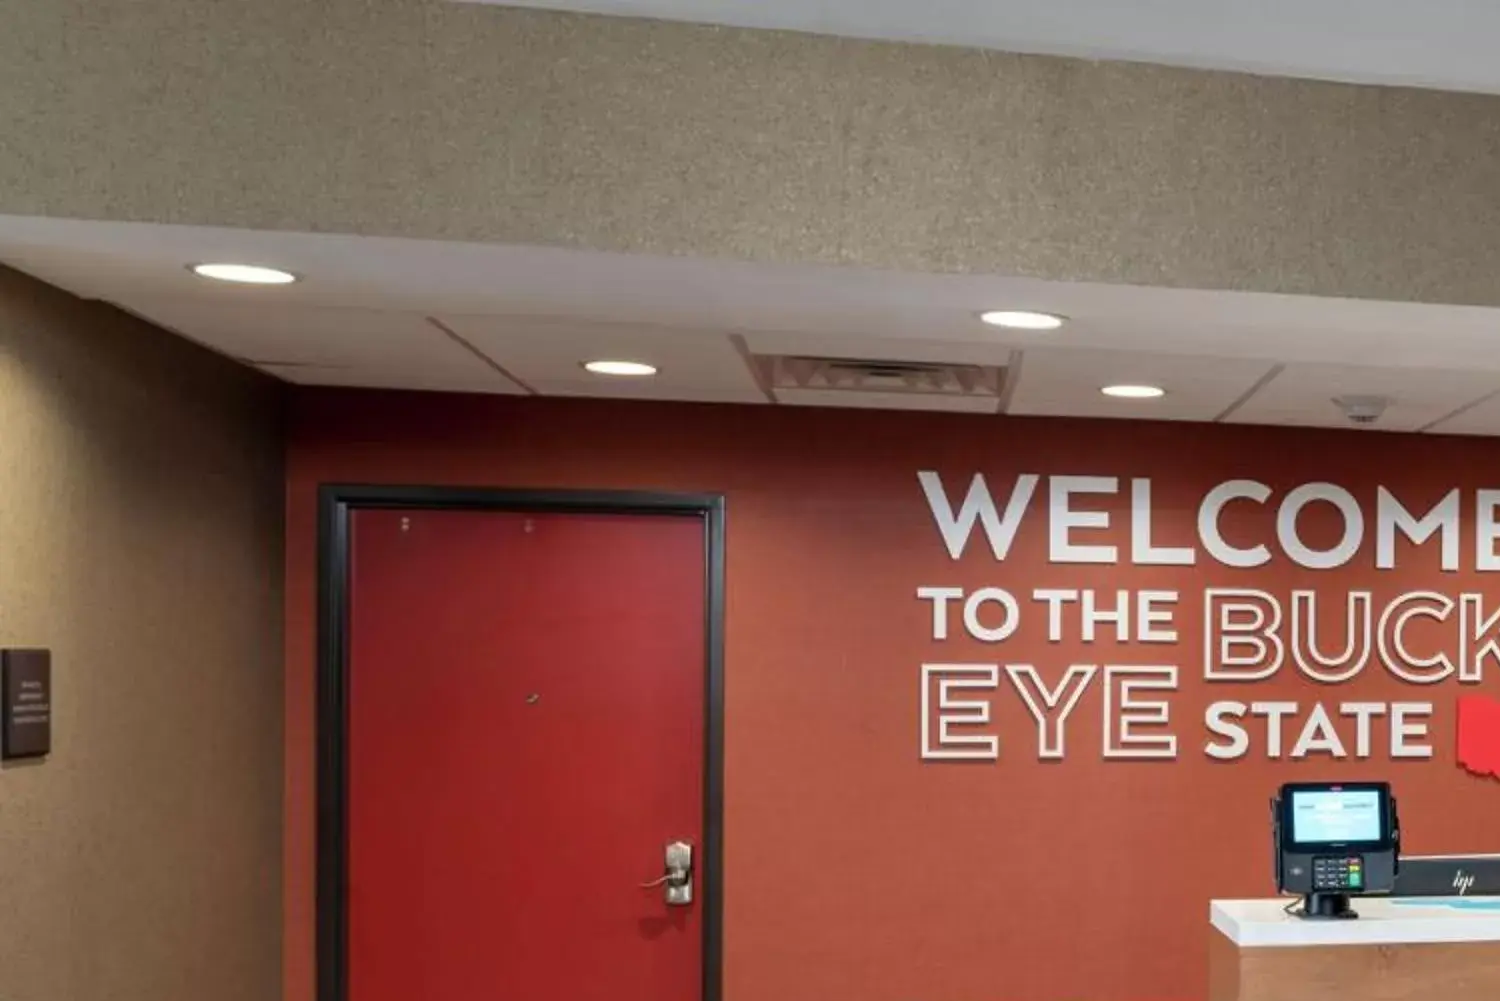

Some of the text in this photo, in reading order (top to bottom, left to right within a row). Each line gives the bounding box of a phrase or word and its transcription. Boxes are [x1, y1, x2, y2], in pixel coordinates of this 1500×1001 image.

[917, 586, 1019, 642] TO
[1033, 589, 1178, 642] THE
[921, 663, 1433, 758] EYE STATE
